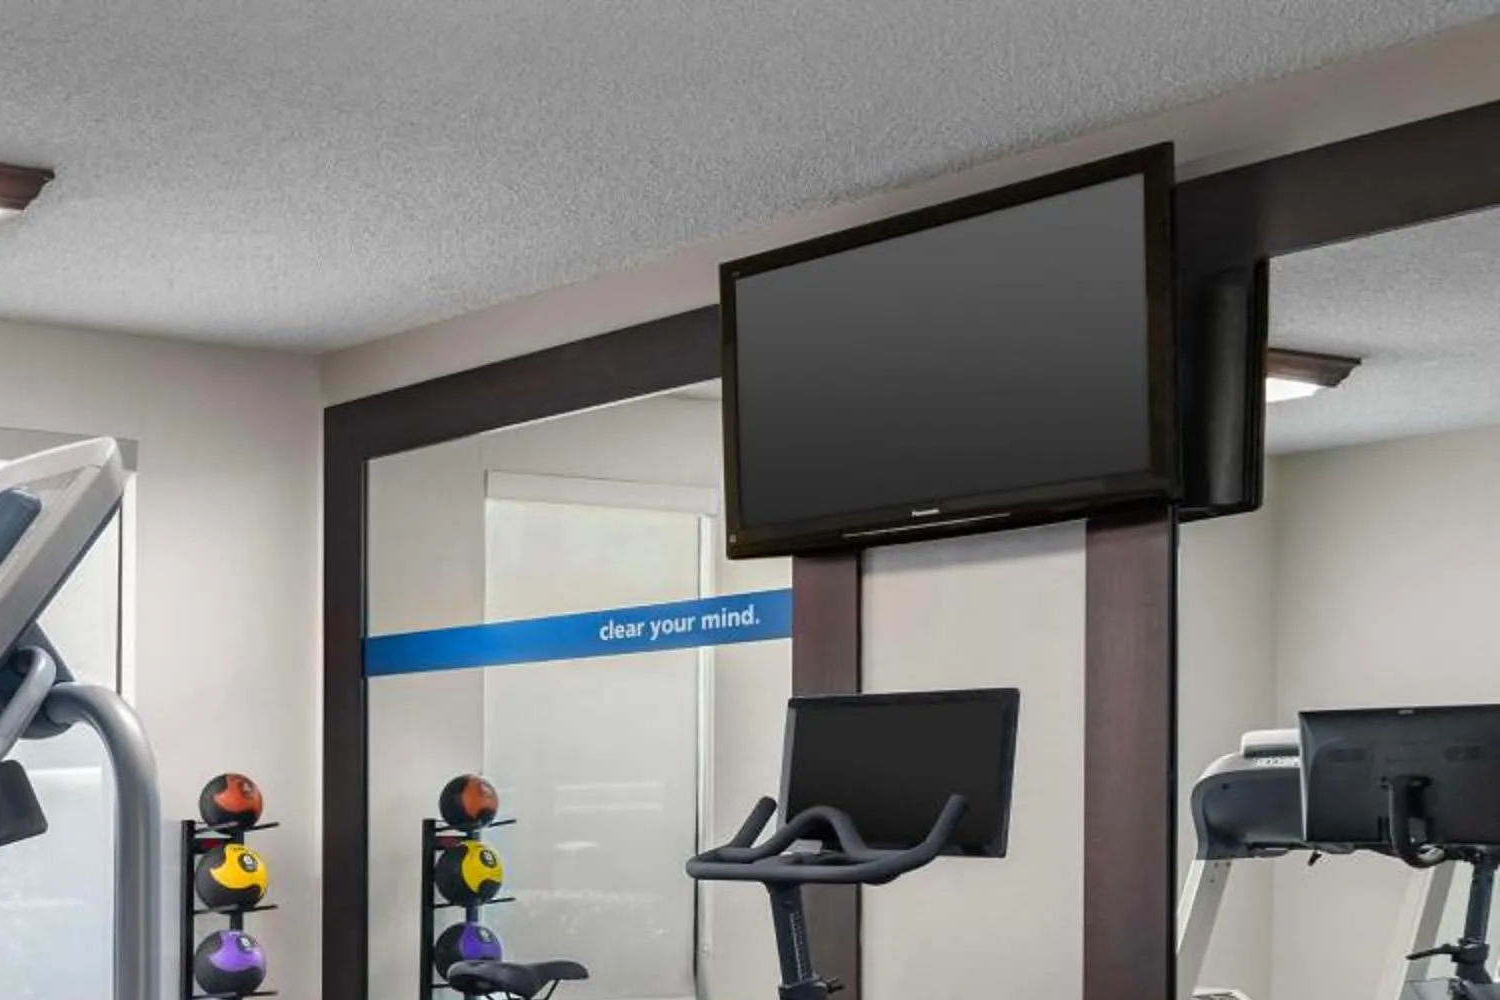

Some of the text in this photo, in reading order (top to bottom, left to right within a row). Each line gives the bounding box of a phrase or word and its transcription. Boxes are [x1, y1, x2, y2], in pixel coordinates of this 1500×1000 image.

[600, 604, 760, 641] clear your mind.
